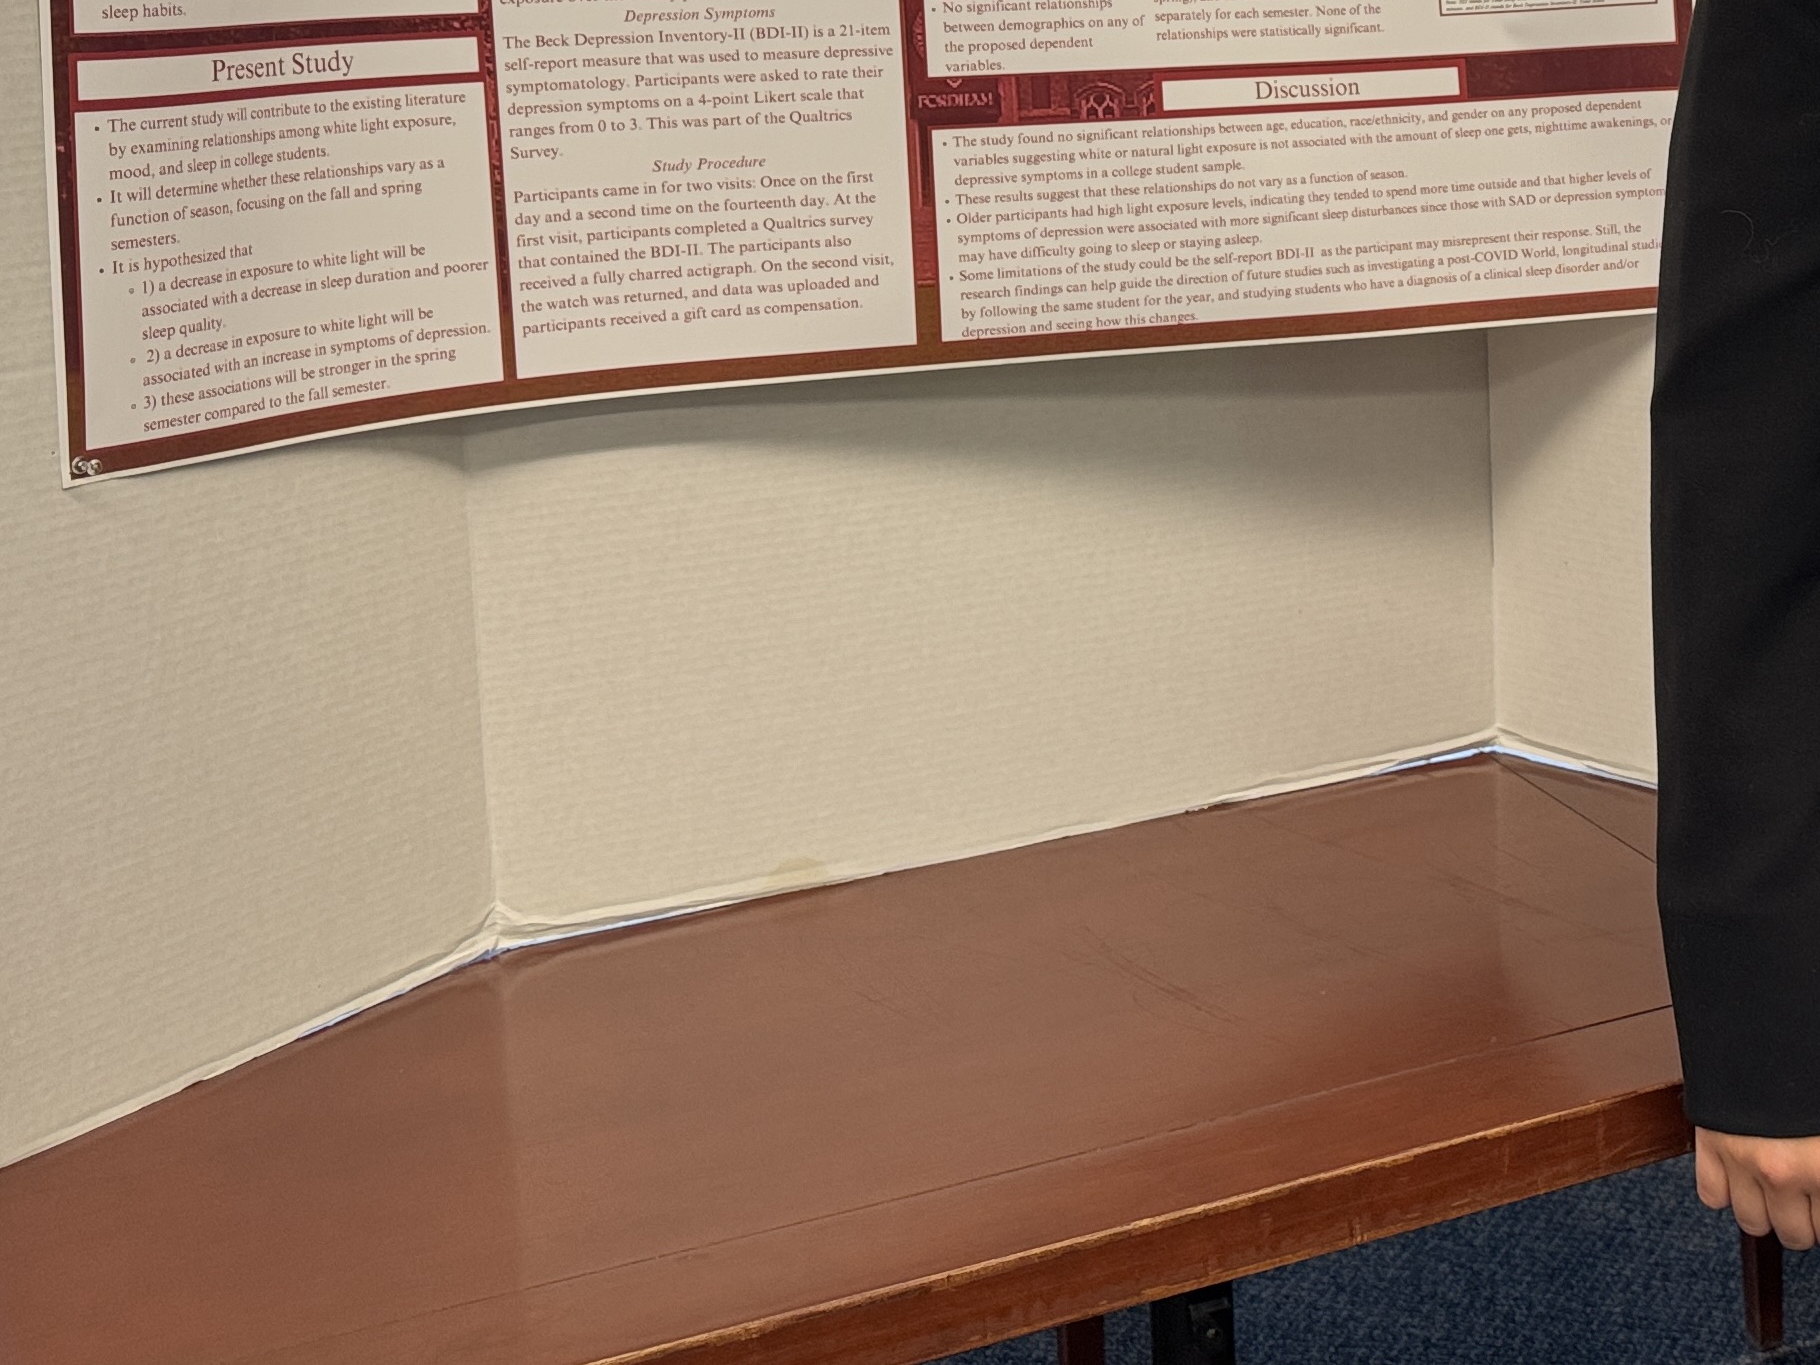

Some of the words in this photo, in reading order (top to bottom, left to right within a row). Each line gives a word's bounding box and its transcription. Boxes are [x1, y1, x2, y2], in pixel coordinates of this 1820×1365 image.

[624, 9, 700, 25] Depression
[704, 7, 775, 23] Symptoms
[942, 1, 963, 13] No
[966, 0, 1032, 15] significant
[502, 35, 530, 49] The
[535, 33, 570, 48] Beck
[574, 33, 654, 49] Depression
[658, 27, 745, 44] Inventory-II
[750, 25, 809, 41] (BDI-II)
[813, 28, 824, 37] is
[828, 28, 836, 37] a
[840, 24, 890, 37] 21-item
[212, 57, 286, 82] Present
[292, 49, 354, 77] Study
[1254, 78, 1360, 100] Discussion
[106, 117, 136, 133] The
[140, 115, 188, 131] current
[191, 110, 224, 127] study
[226, 107, 248, 122] will
[250, 103, 310, 120] contribute
[314, 103, 327, 113] to
[330, 99, 350, 112] the
[352, 98, 402, 111] existing
[404, 93, 466, 107] literature
[652, 158, 692, 174] Study
[697, 155, 766, 171] Procedure
[955, 193, 991, 205] These
[994, 190, 1034, 203] results
[1036, 189, 1080, 203] suggest
[1083, 186, 1107, 198] that
[1110, 185, 1140, 197] these
[1143, 180, 1217, 195] relationships
[1219, 178, 1234, 190] do
[1237, 179, 1256, 189] not
[1258, 178, 1283, 189] vary
[1286, 177, 1298, 185] as
[1300, 176, 1307, 185] a
[1309, 173, 1354, 184] function
[1356, 169, 1368, 181] of
[1370, 170, 1407, 180] season.
[142, 362, 211, 387] associated
[214, 357, 241, 374] with
[244, 357, 259, 369] an
[262, 348, 312, 365] increase
[314, 345, 327, 357] in
[330, 335, 396, 357] symptoms
[399, 329, 414, 344] of
[416, 325, 490, 343] depression.
